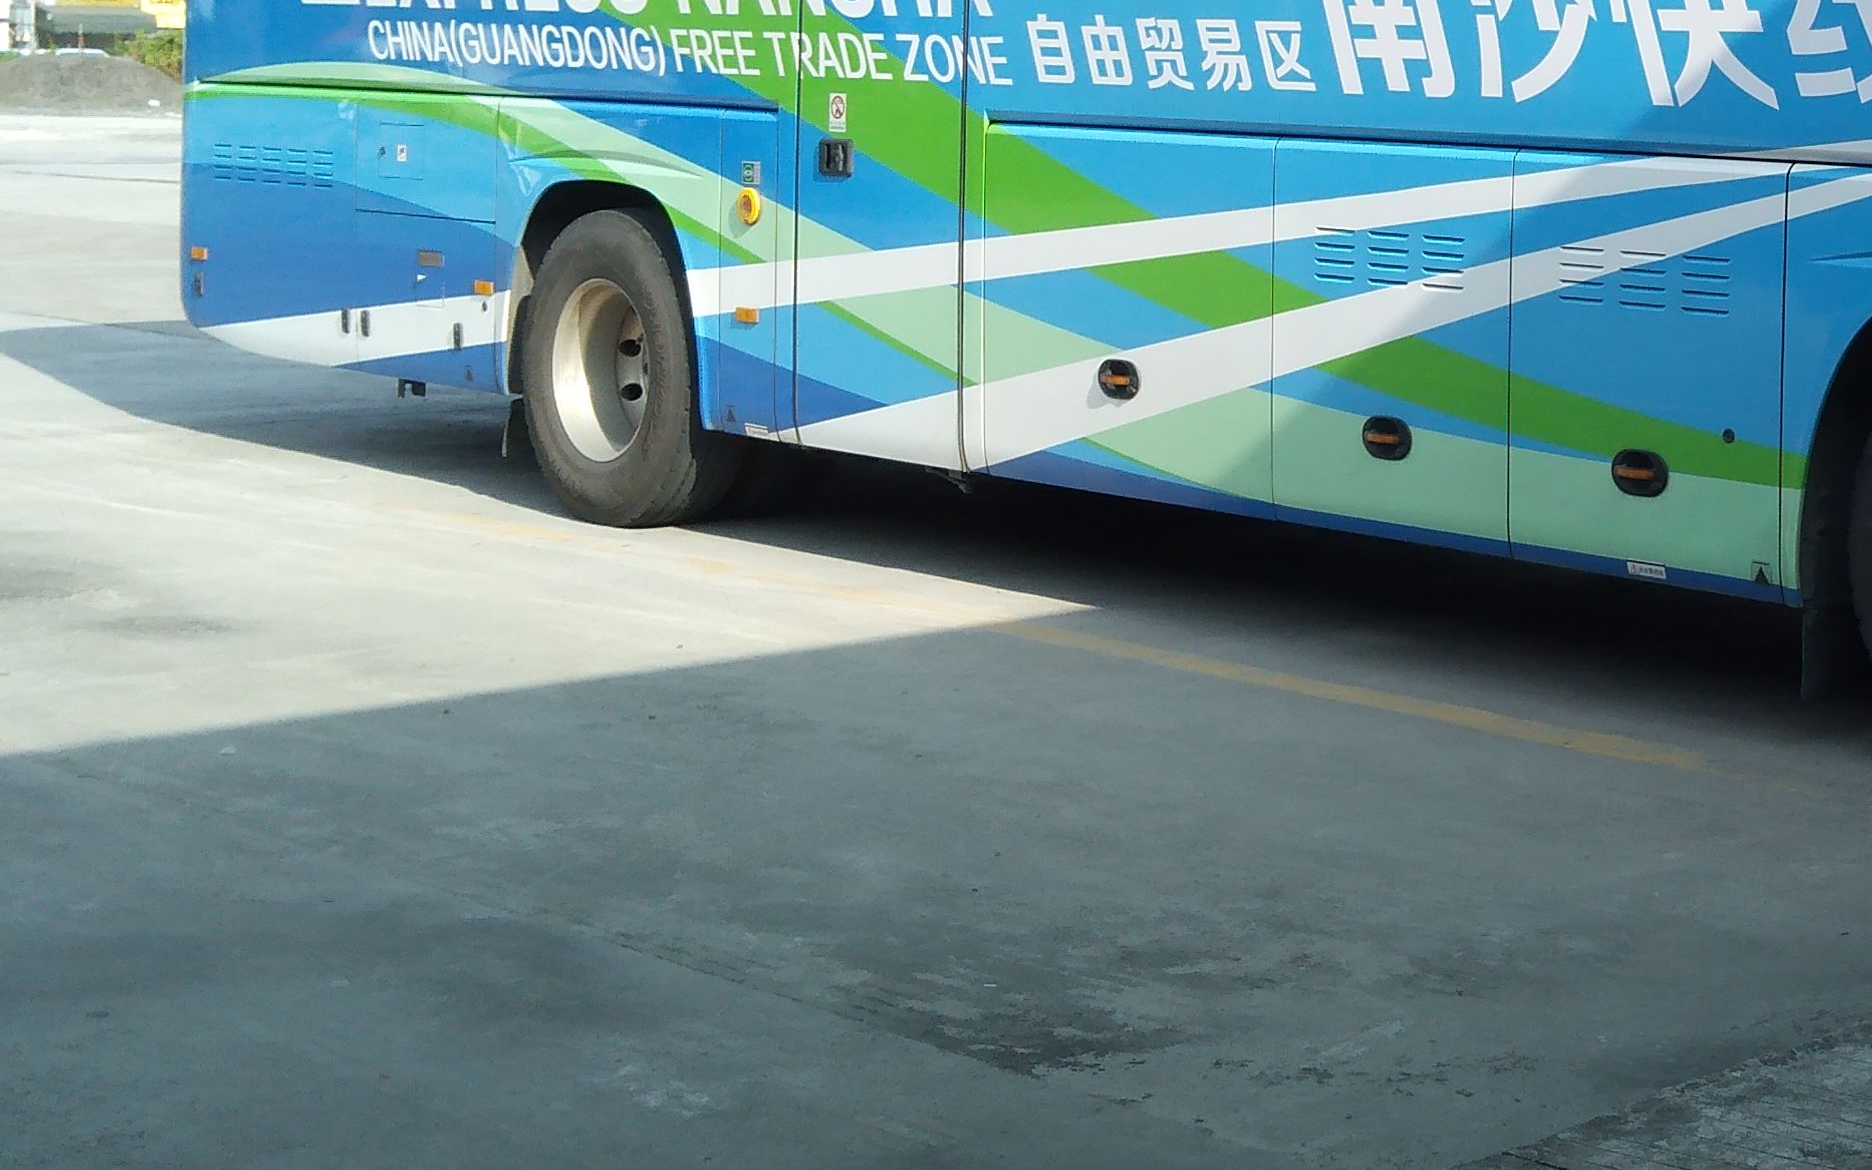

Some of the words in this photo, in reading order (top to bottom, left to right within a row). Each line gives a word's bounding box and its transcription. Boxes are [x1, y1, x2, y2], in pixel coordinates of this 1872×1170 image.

[368, 19, 667, 76] CHINA(GUANGDONG)
[674, 33, 761, 76] FREE
[772, 33, 896, 82] TRADE
[903, 35, 1013, 86] ZONE
[1029, 12, 1318, 94] 自由贸易区
